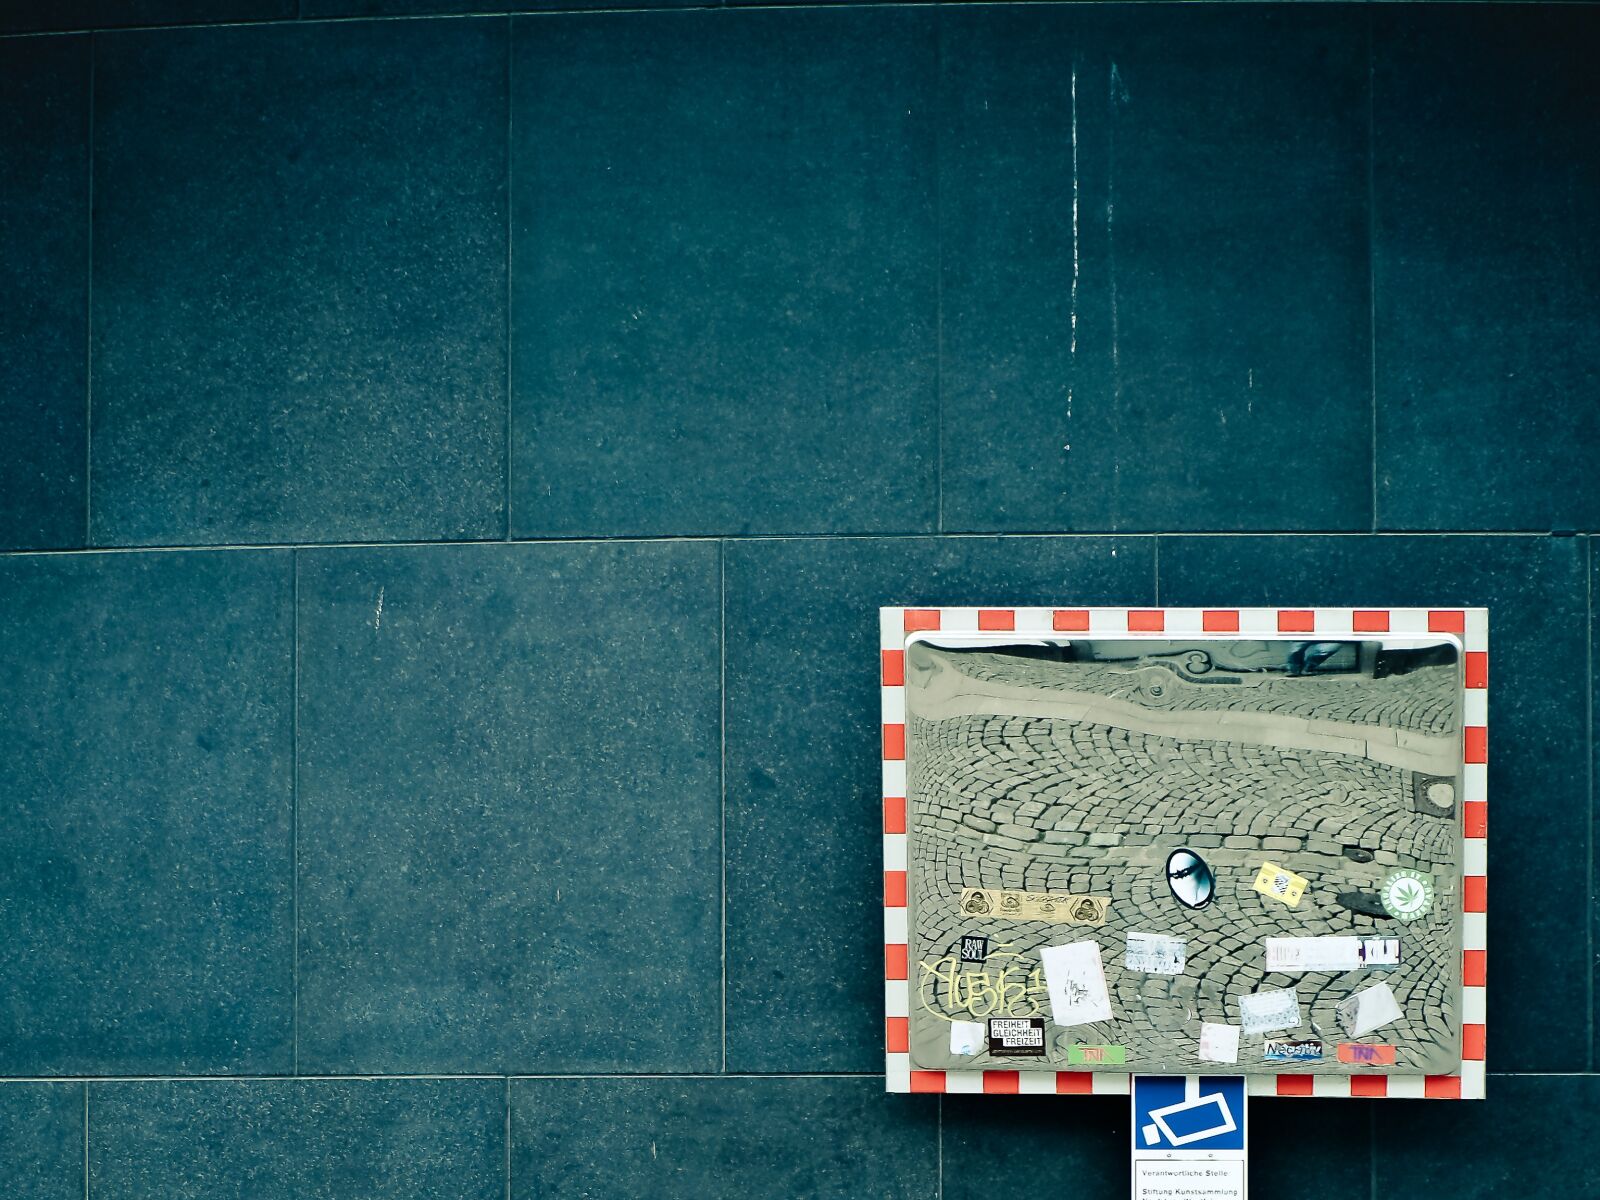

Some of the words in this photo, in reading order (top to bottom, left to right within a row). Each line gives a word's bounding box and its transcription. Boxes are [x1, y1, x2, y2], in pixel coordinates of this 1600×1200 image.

[964, 938, 984, 950] RAW
[962, 949, 985, 960] SOUL
[992, 1020, 1029, 1028] FREIHEIT
[993, 1029, 1040, 1037] GLEICHHEIT
[1005, 1037, 1041, 1046] FREIZEIT
[1142, 1188, 1173, 1196] Stiftung
[1175, 1188, 1238, 1196] Kunstsammlung
